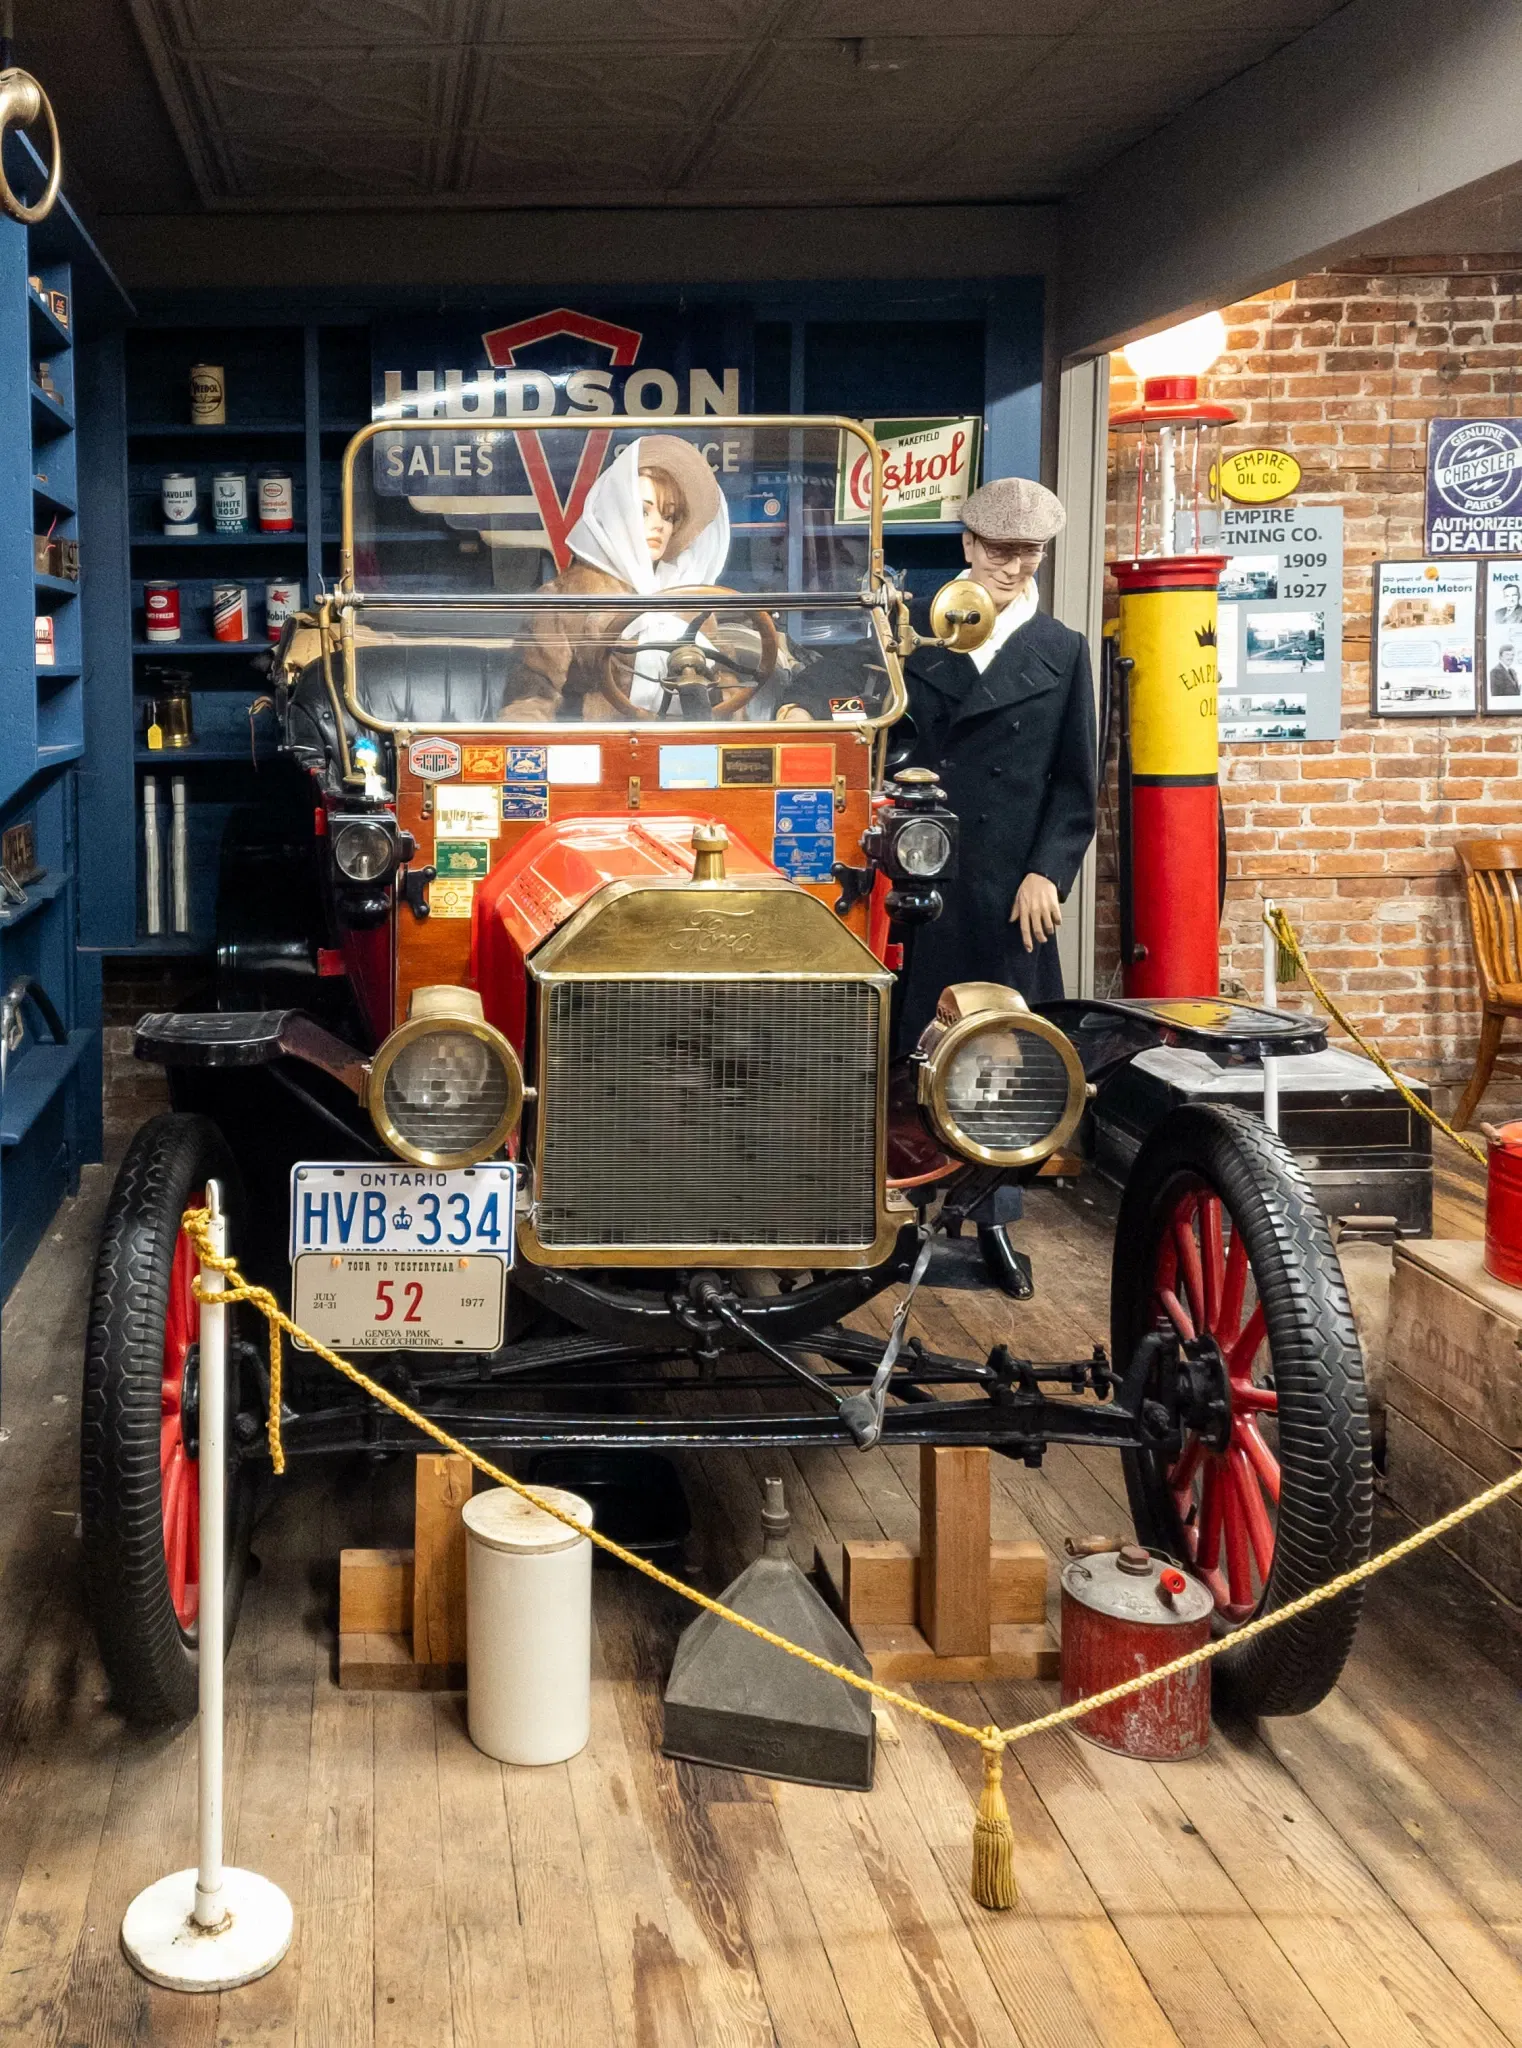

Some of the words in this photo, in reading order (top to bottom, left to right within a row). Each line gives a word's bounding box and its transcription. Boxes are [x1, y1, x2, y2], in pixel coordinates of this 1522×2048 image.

[384, 368, 739, 418] HUDSON
[898, 431, 940, 448] WAKEFIELD
[1450, 426, 1506, 447] GENUINE
[386, 445, 494, 477] SALES
[1234, 452, 1289, 472] EMPIRE
[1443, 452, 1516, 485] CHRYSLER
[1237, 474, 1256, 485] OIL
[1262, 473, 1281, 485] CO.
[898, 488, 926, 502] MOTOR
[929, 484, 941, 496] OIL
[216, 500, 240, 508] WHITE
[1464, 495, 1503, 511] PARTS
[218, 507, 239, 515] ROSE
[1224, 509, 1295, 525] EMPIRE
[1291, 527, 1322, 542] CO.
[1431, 531, 1522, 552] DEALER
[1284, 553, 1327, 568] 1909
[1493, 573, 1519, 582] Meet
[1284, 583, 1327, 598] 1927
[1382, 585, 1433, 594] Patterson
[1437, 584, 1473, 593] Motors
[667, 908, 757, 954] Ford
[360, 1173, 447, 1186] ONTARIO
[303, 1191, 387, 1245] HVB
[416, 1192, 501, 1245] 334
[348, 1262, 370, 1272] TOUR
[377, 1262, 388, 1271] TO
[395, 1262, 454, 1272] YESTERYEAR
[313, 1301, 337, 1309] 24-31
[375, 1281, 423, 1322] 52
[460, 1298, 485, 1307] 1977
[365, 1330, 401, 1338] GENEVA
[406, 1330, 431, 1338] PARK
[352, 1338, 377, 1346] LAKE
[380, 1338, 443, 1346] COUCHICHING
